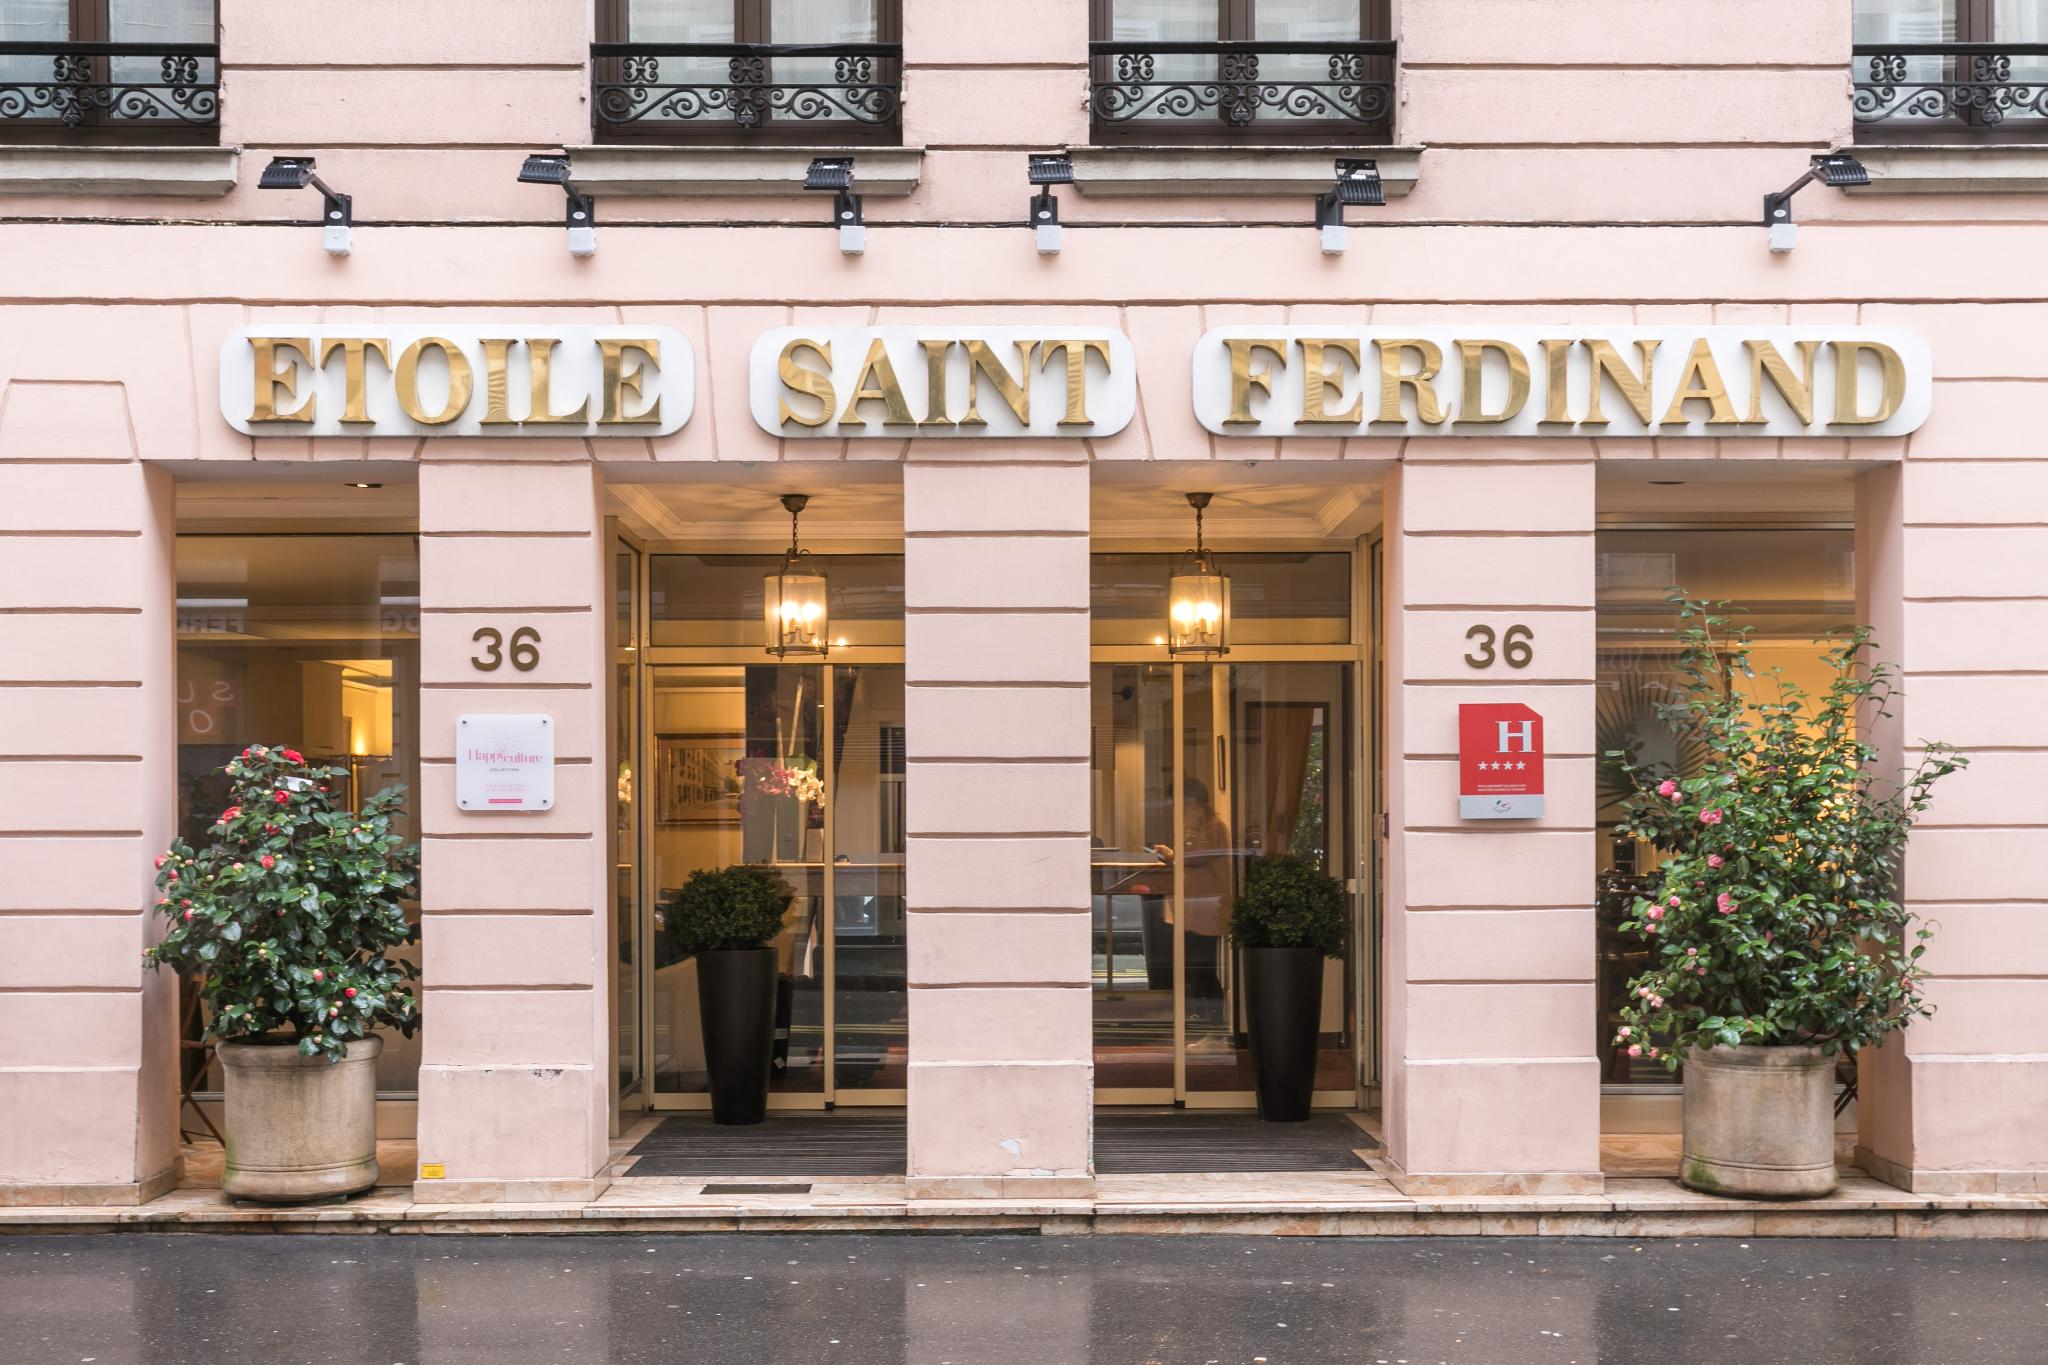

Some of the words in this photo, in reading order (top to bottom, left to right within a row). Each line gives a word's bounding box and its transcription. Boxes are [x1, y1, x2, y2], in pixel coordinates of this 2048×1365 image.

[245, 336, 662, 425] ETOILE
[778, 337, 1111, 428] SAINT
[1221, 337, 1907, 427] FERDINAND
[471, 626, 541, 672] 36
[1464, 624, 1534, 669] 36
[1494, 720, 1536, 753] H
